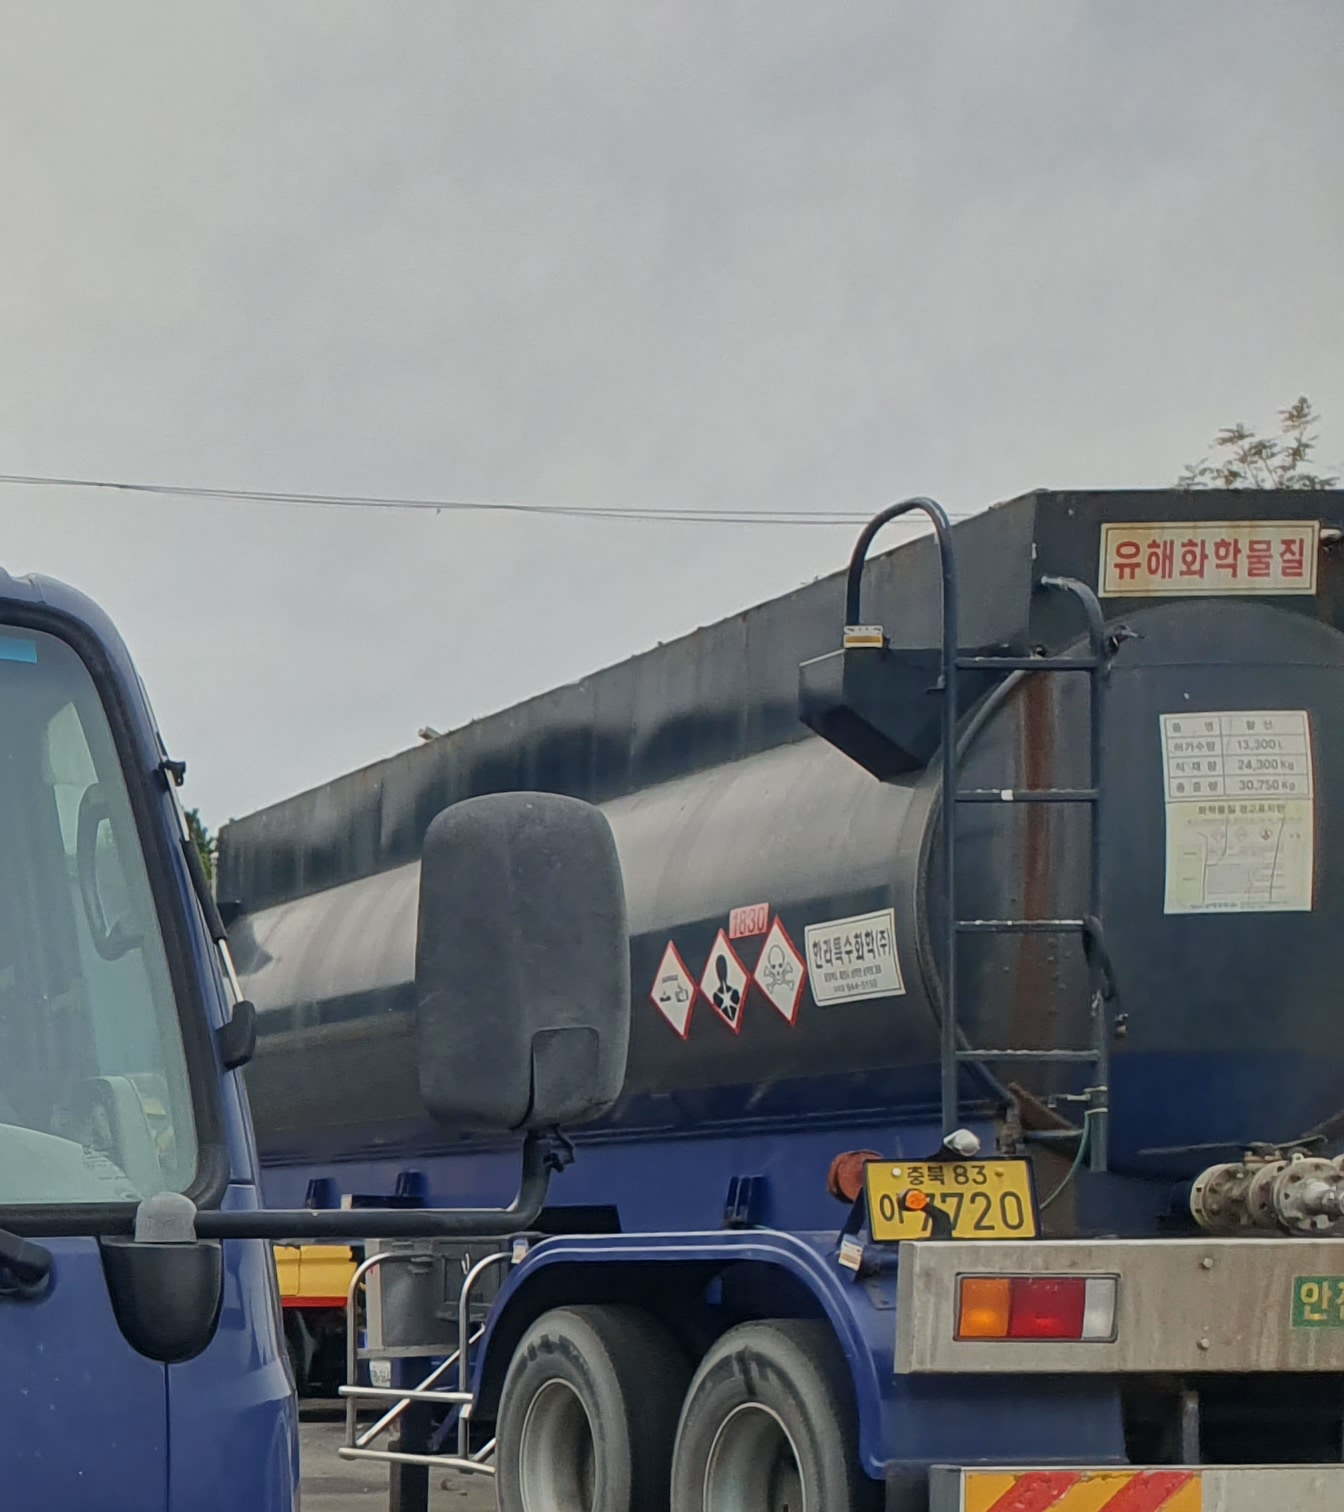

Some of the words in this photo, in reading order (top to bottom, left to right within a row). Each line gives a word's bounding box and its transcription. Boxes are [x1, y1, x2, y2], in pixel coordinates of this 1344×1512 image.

[1113, 537, 1305, 580] 유해화학물질
[732, 906, 765, 937] 1830
[907, 1166, 945, 1185] 충북
[952, 1164, 988, 1185] 83
